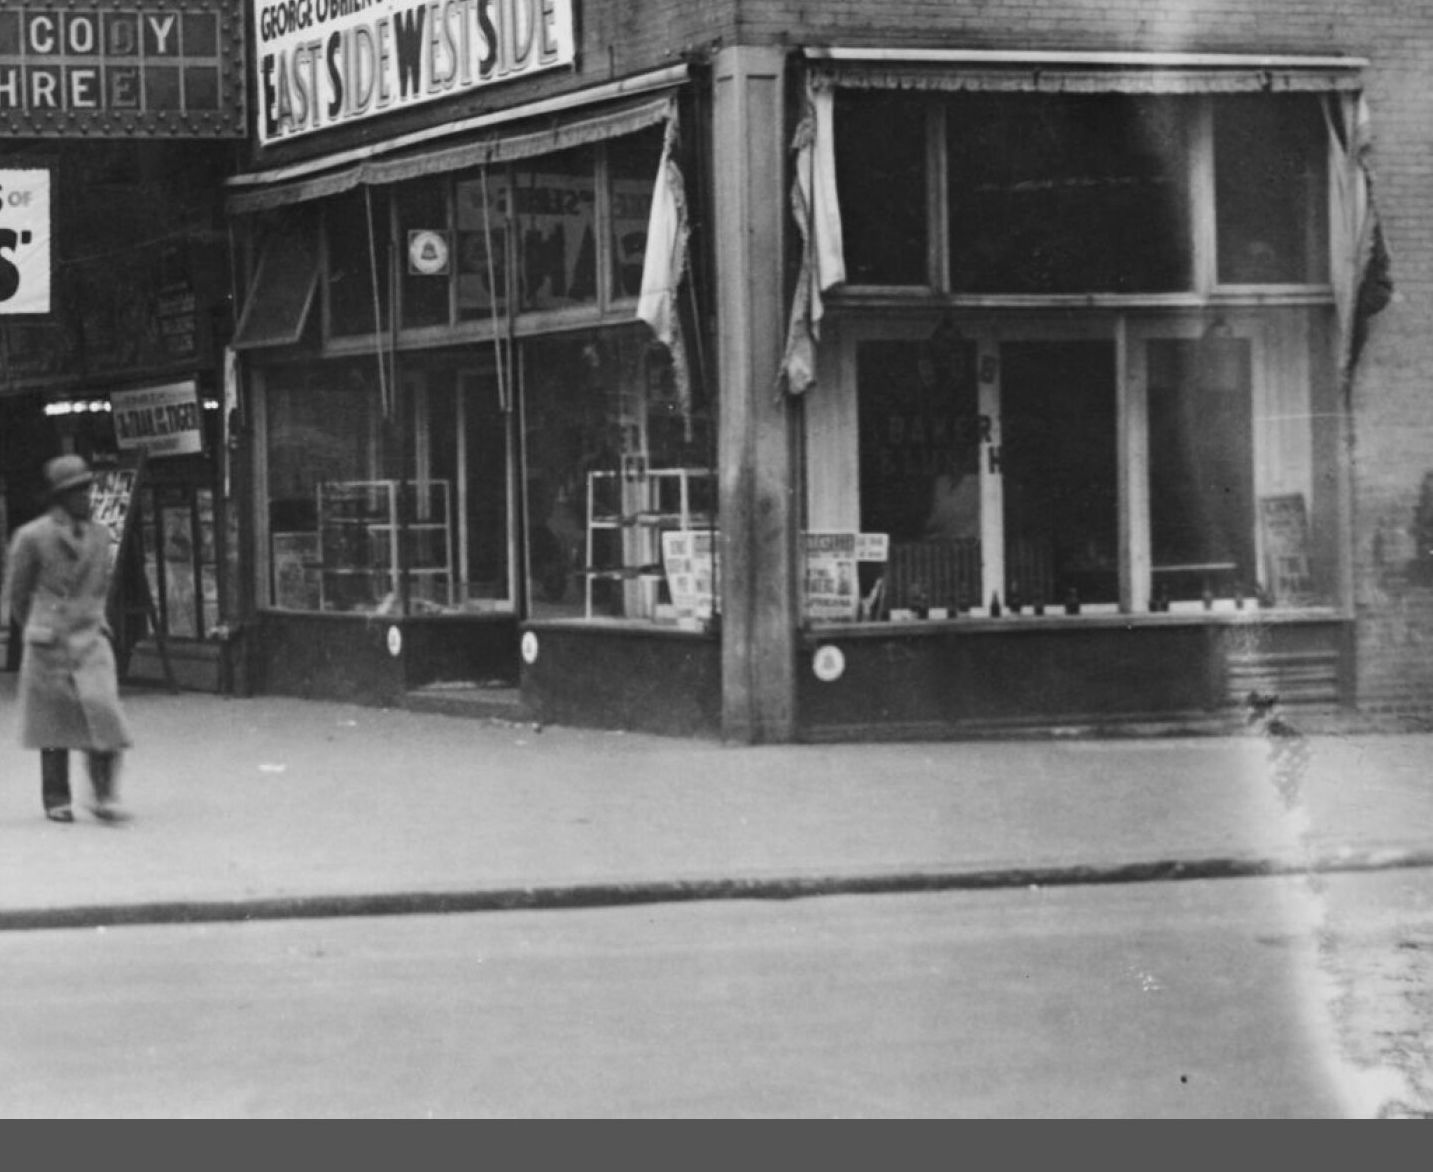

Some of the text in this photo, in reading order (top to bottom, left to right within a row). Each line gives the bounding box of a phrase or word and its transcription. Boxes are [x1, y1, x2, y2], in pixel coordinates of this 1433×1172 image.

[29, 15, 176, 55] CODY
[261, 38, 323, 137] EAST
[326, 16, 390, 121] SIDE
[7, 189, 33, 208] OF
